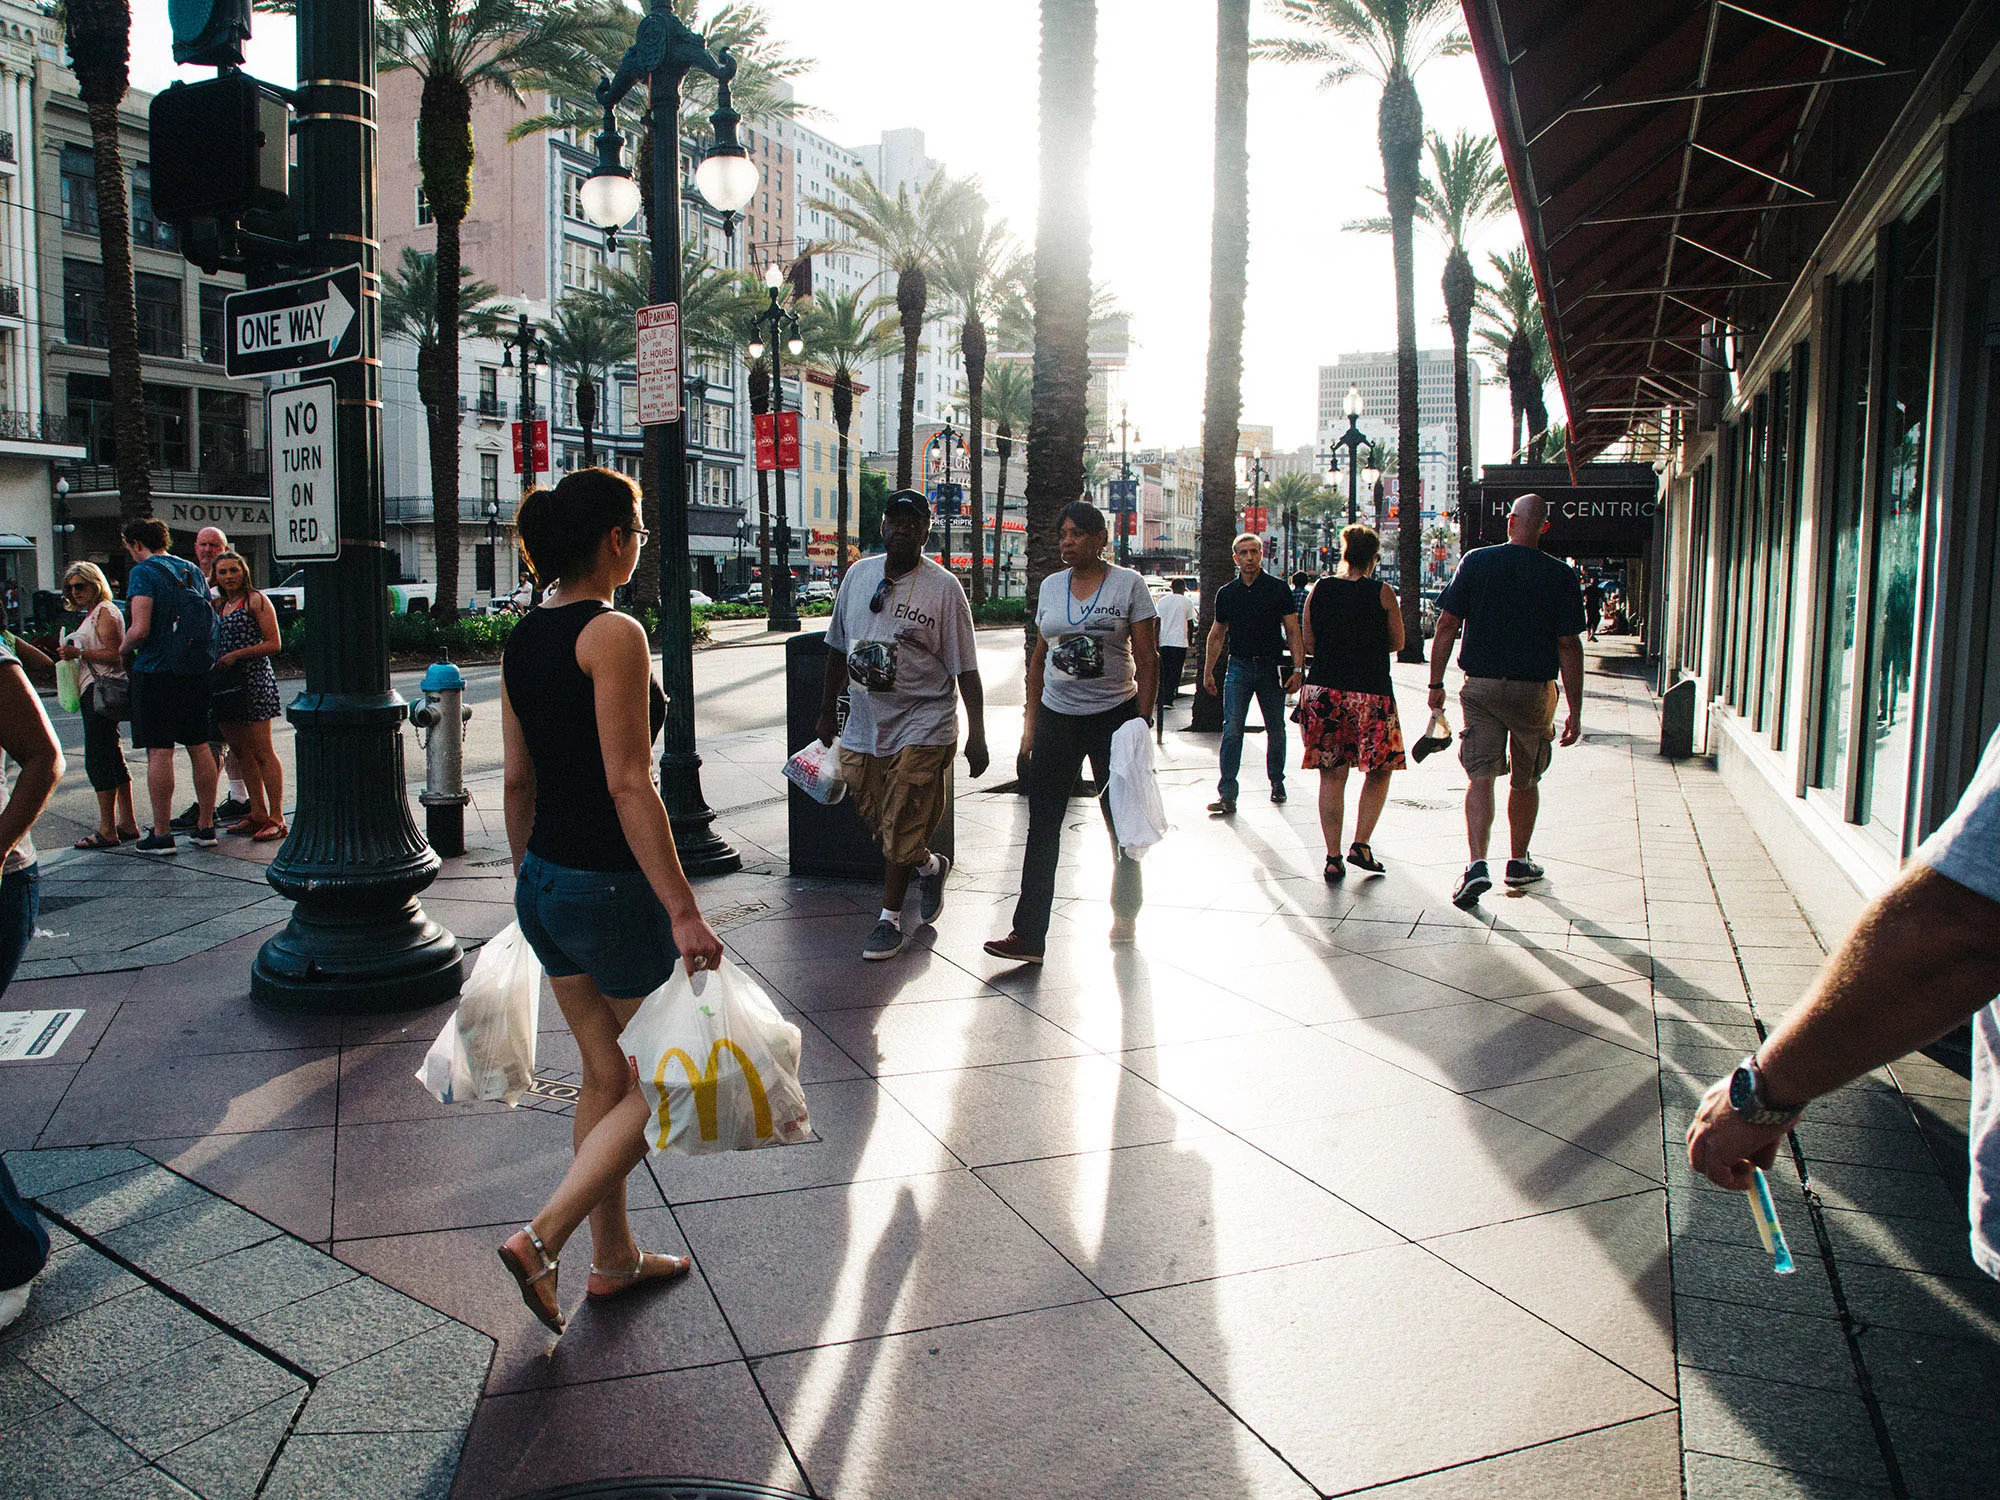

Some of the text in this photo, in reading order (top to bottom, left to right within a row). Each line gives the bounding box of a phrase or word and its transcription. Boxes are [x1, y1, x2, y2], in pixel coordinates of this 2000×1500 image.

[242, 304, 325, 350] ONE WAY
[638, 309, 675, 327] NO PARKING
[642, 347, 673, 360] 2 HOURS
[659, 358, 674, 366] PARADE
[285, 402, 317, 437] NO
[282, 445, 321, 472] TURN
[291, 482, 313, 507] ON
[172, 504, 271, 524] NOUVEA
[1562, 501, 1655, 519] CENTRIC
[289, 518, 318, 543] RED
[894, 603, 936, 630] Eldon
[1080, 604, 1121, 617] Wanda
